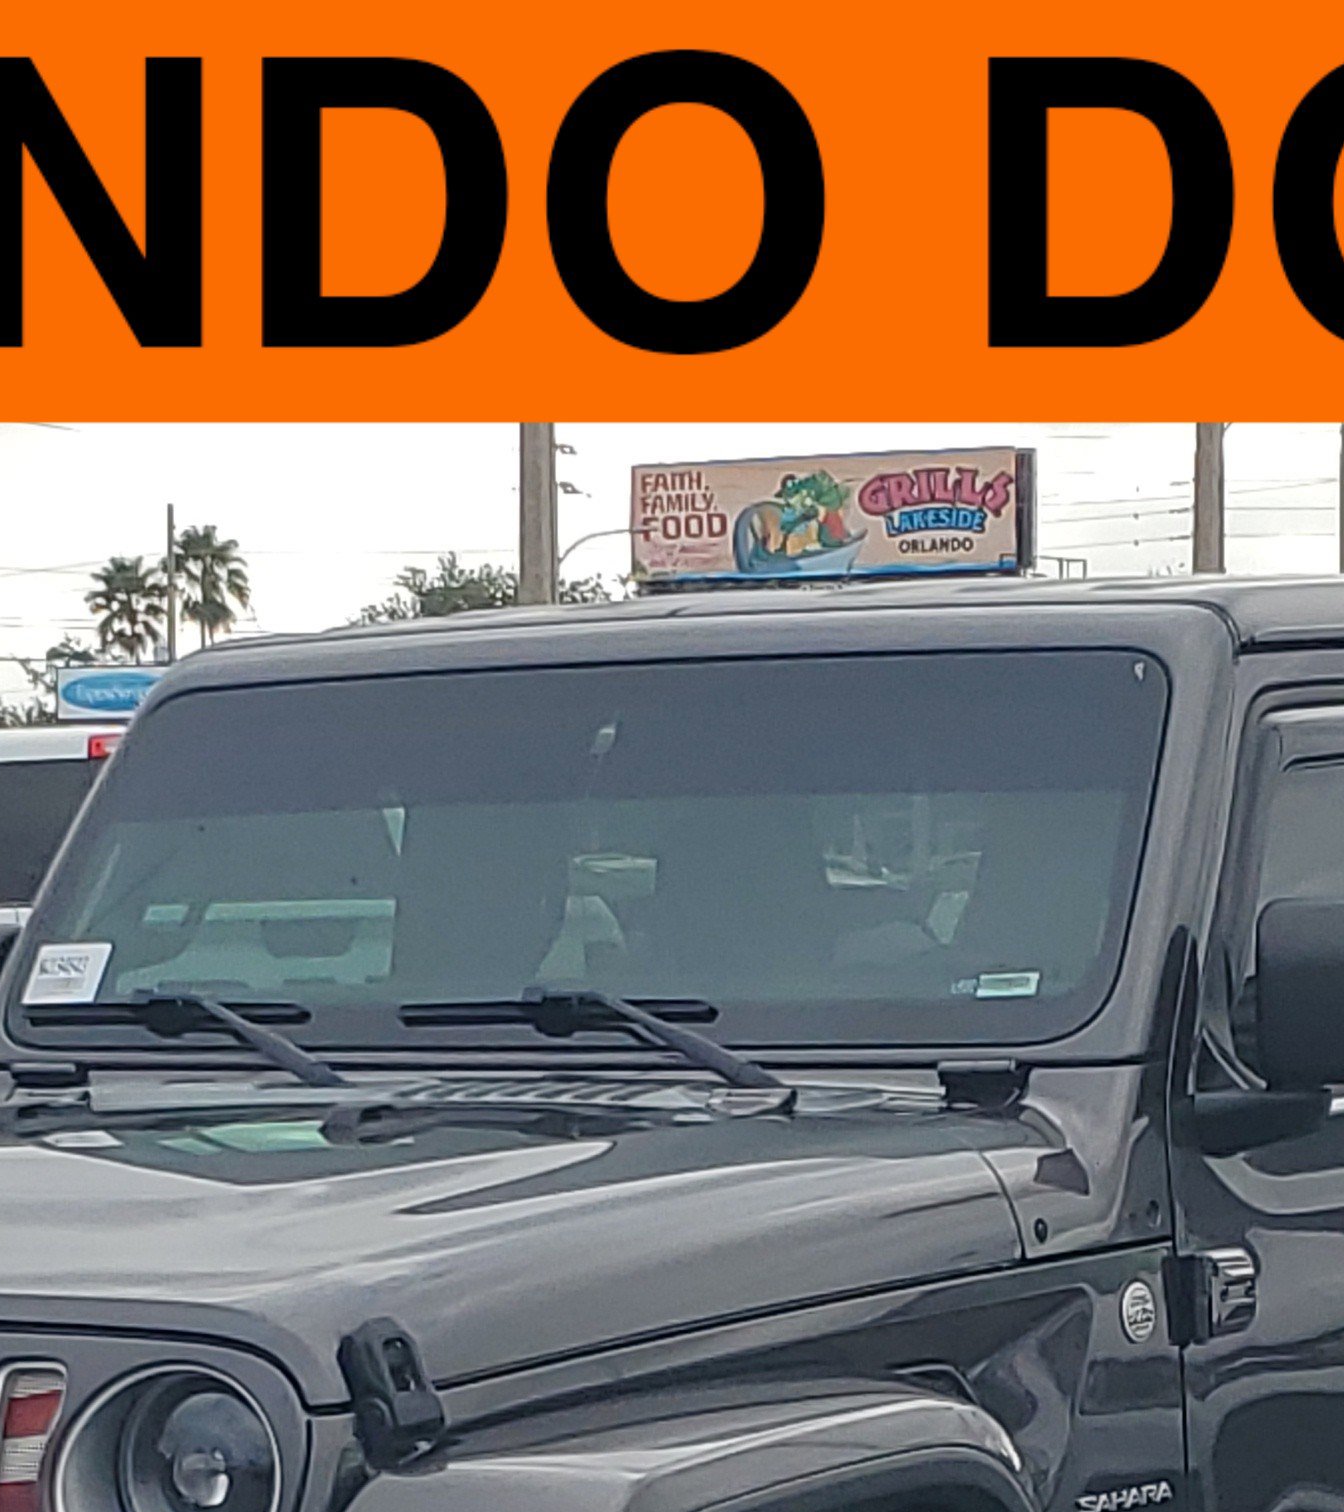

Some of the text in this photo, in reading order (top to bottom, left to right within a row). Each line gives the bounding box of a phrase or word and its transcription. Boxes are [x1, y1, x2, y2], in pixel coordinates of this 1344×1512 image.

[858, 466, 1014, 518] GRILLS
[642, 512, 728, 542] FOOD
[885, 506, 988, 538] LAKESIDE
[898, 536, 974, 554] ORLANDO
